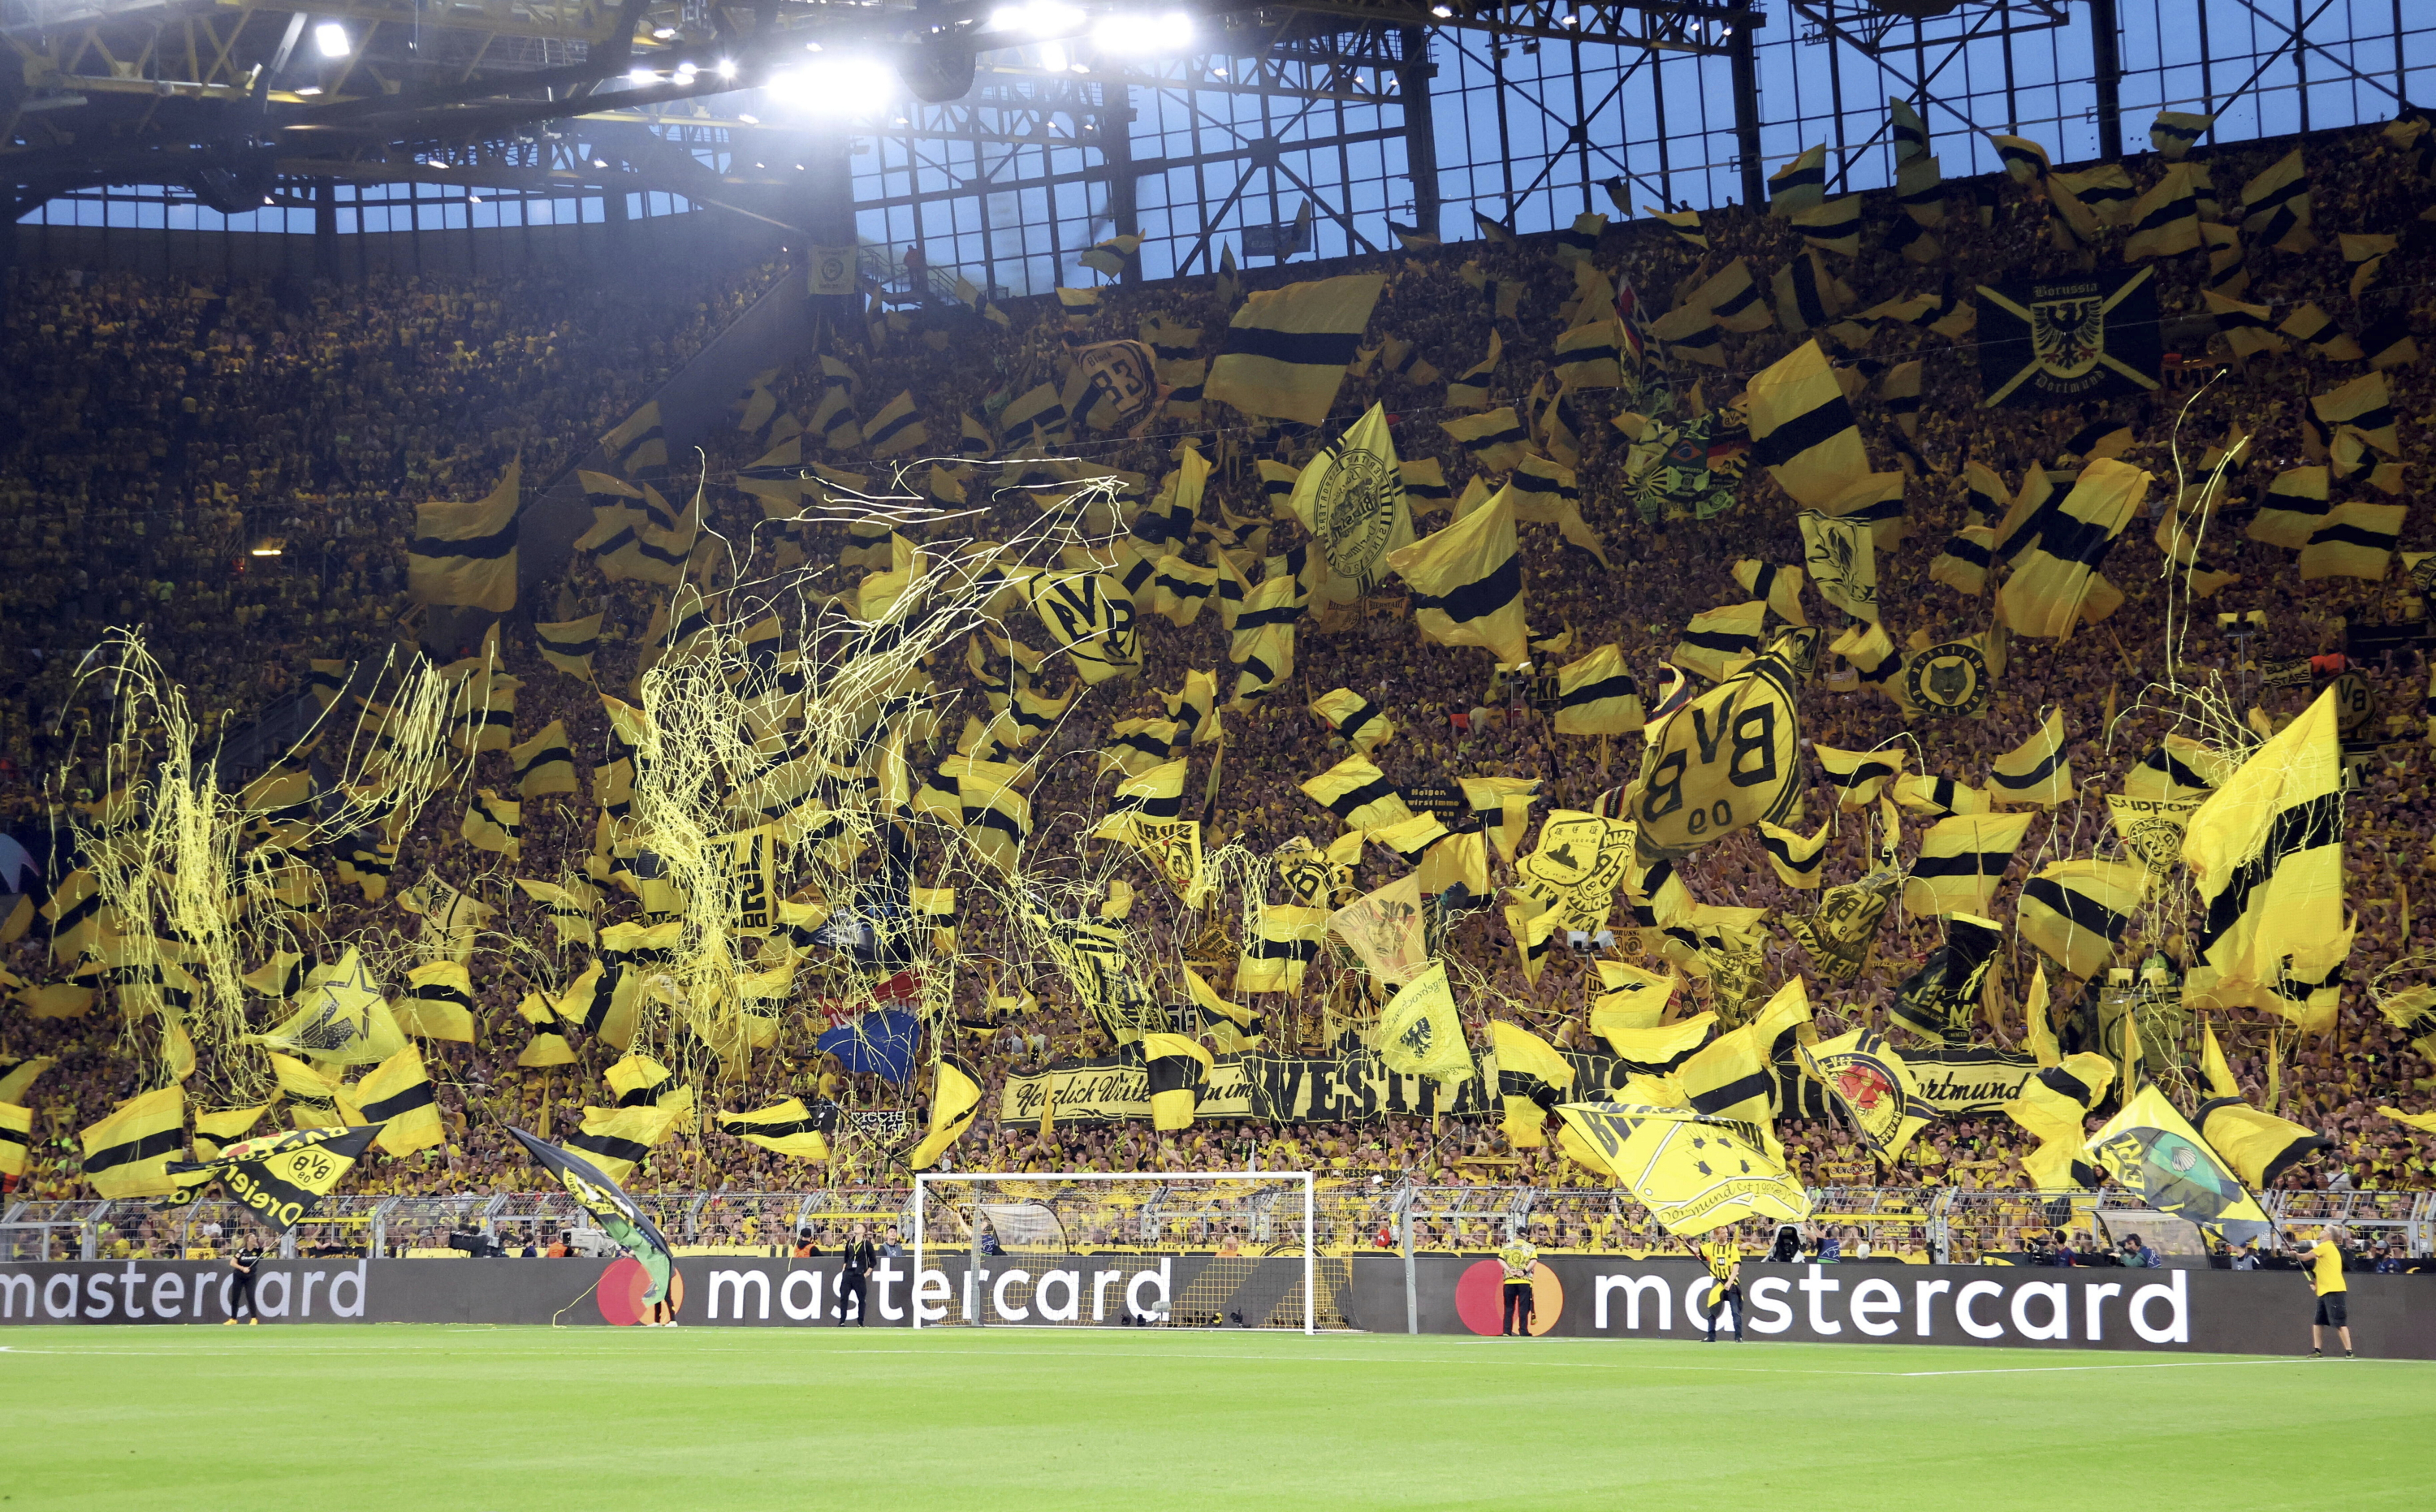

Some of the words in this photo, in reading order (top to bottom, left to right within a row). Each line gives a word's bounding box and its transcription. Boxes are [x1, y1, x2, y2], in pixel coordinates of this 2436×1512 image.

[2032, 283, 2097, 298] Borussia
[2034, 369, 2106, 393] Dortmund
[1224, 1073, 1255, 1098] im
